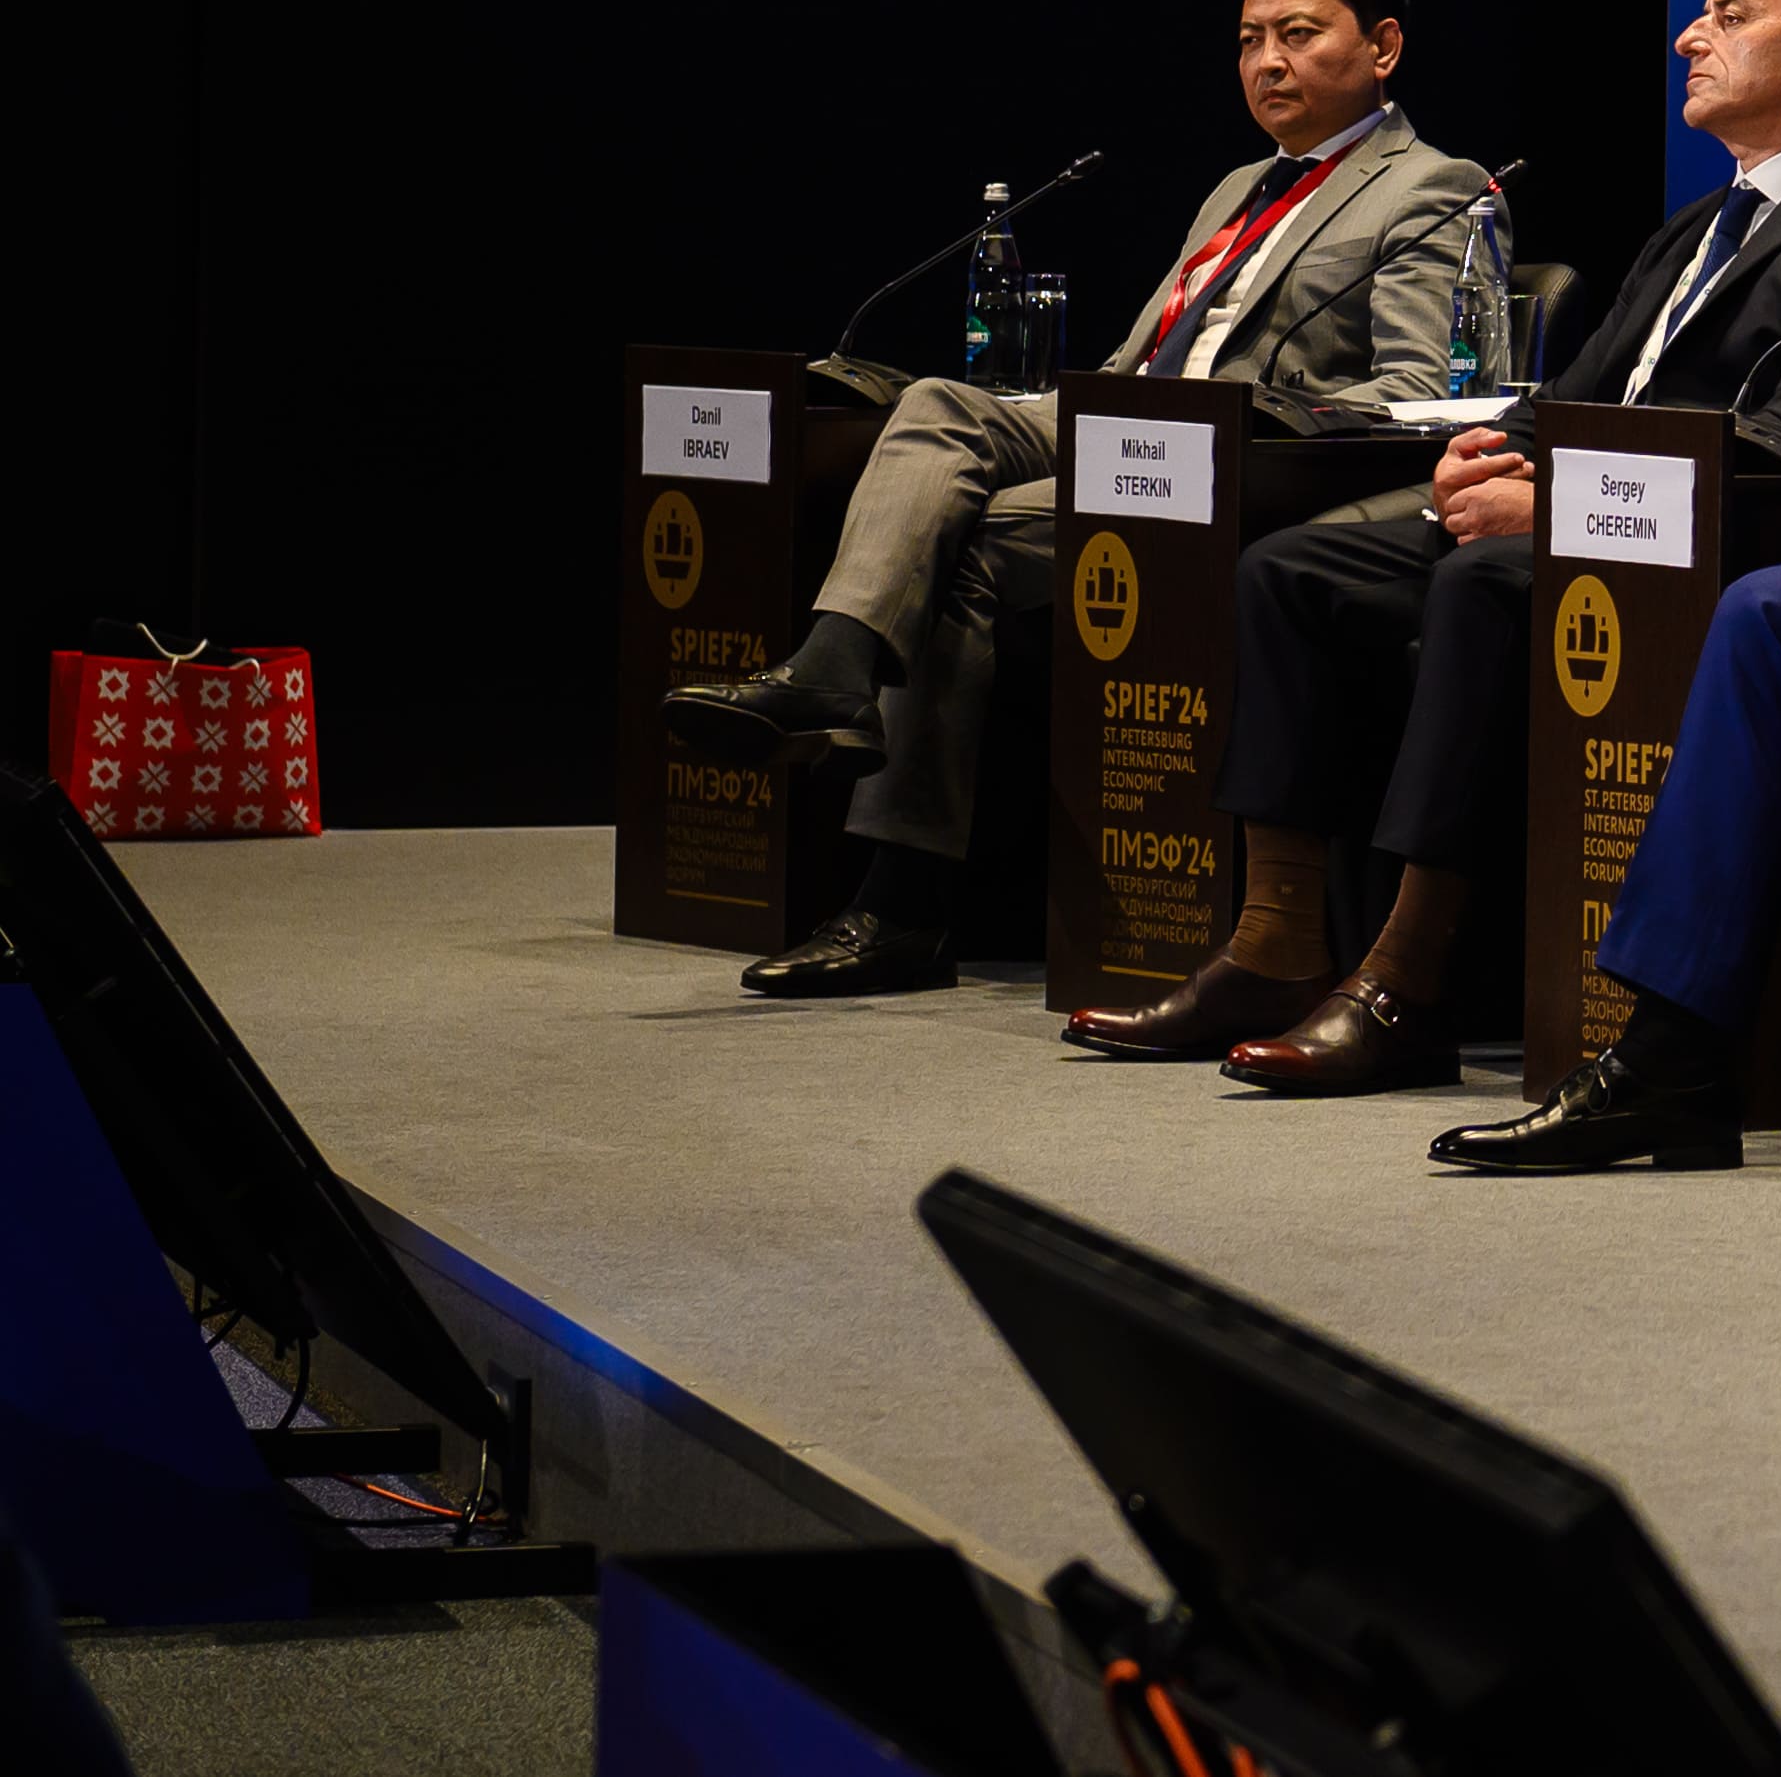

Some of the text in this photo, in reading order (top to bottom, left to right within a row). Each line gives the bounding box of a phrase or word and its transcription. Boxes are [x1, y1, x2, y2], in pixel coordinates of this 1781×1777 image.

[691, 406, 722, 427] Danil
[683, 438, 730, 461] IBRAEV
[1121, 438, 1166, 462] Mikhail
[1114, 474, 1172, 501] STERKIN
[1600, 473, 1646, 504] Sergey
[1586, 512, 1658, 541] CHEREMIN
[671, 627, 767, 670] SPIEF'24
[1104, 679, 1207, 726] SPIEF'24
[1103, 727, 1193, 752] ST. PETERSBURG
[1103, 749, 1197, 775] INTERNATIONAL
[667, 761, 773, 808] ПМЭФ'24
[1103, 770, 1166, 794] ECONOMIC
[1103, 792, 1144, 814] FORUM
[1584, 788, 1600, 807] ST.
[1102, 827, 1216, 878] ПМЭФ'24
[1584, 836, 1639, 860] ECONOM
[1584, 861, 1626, 884] FORUM
